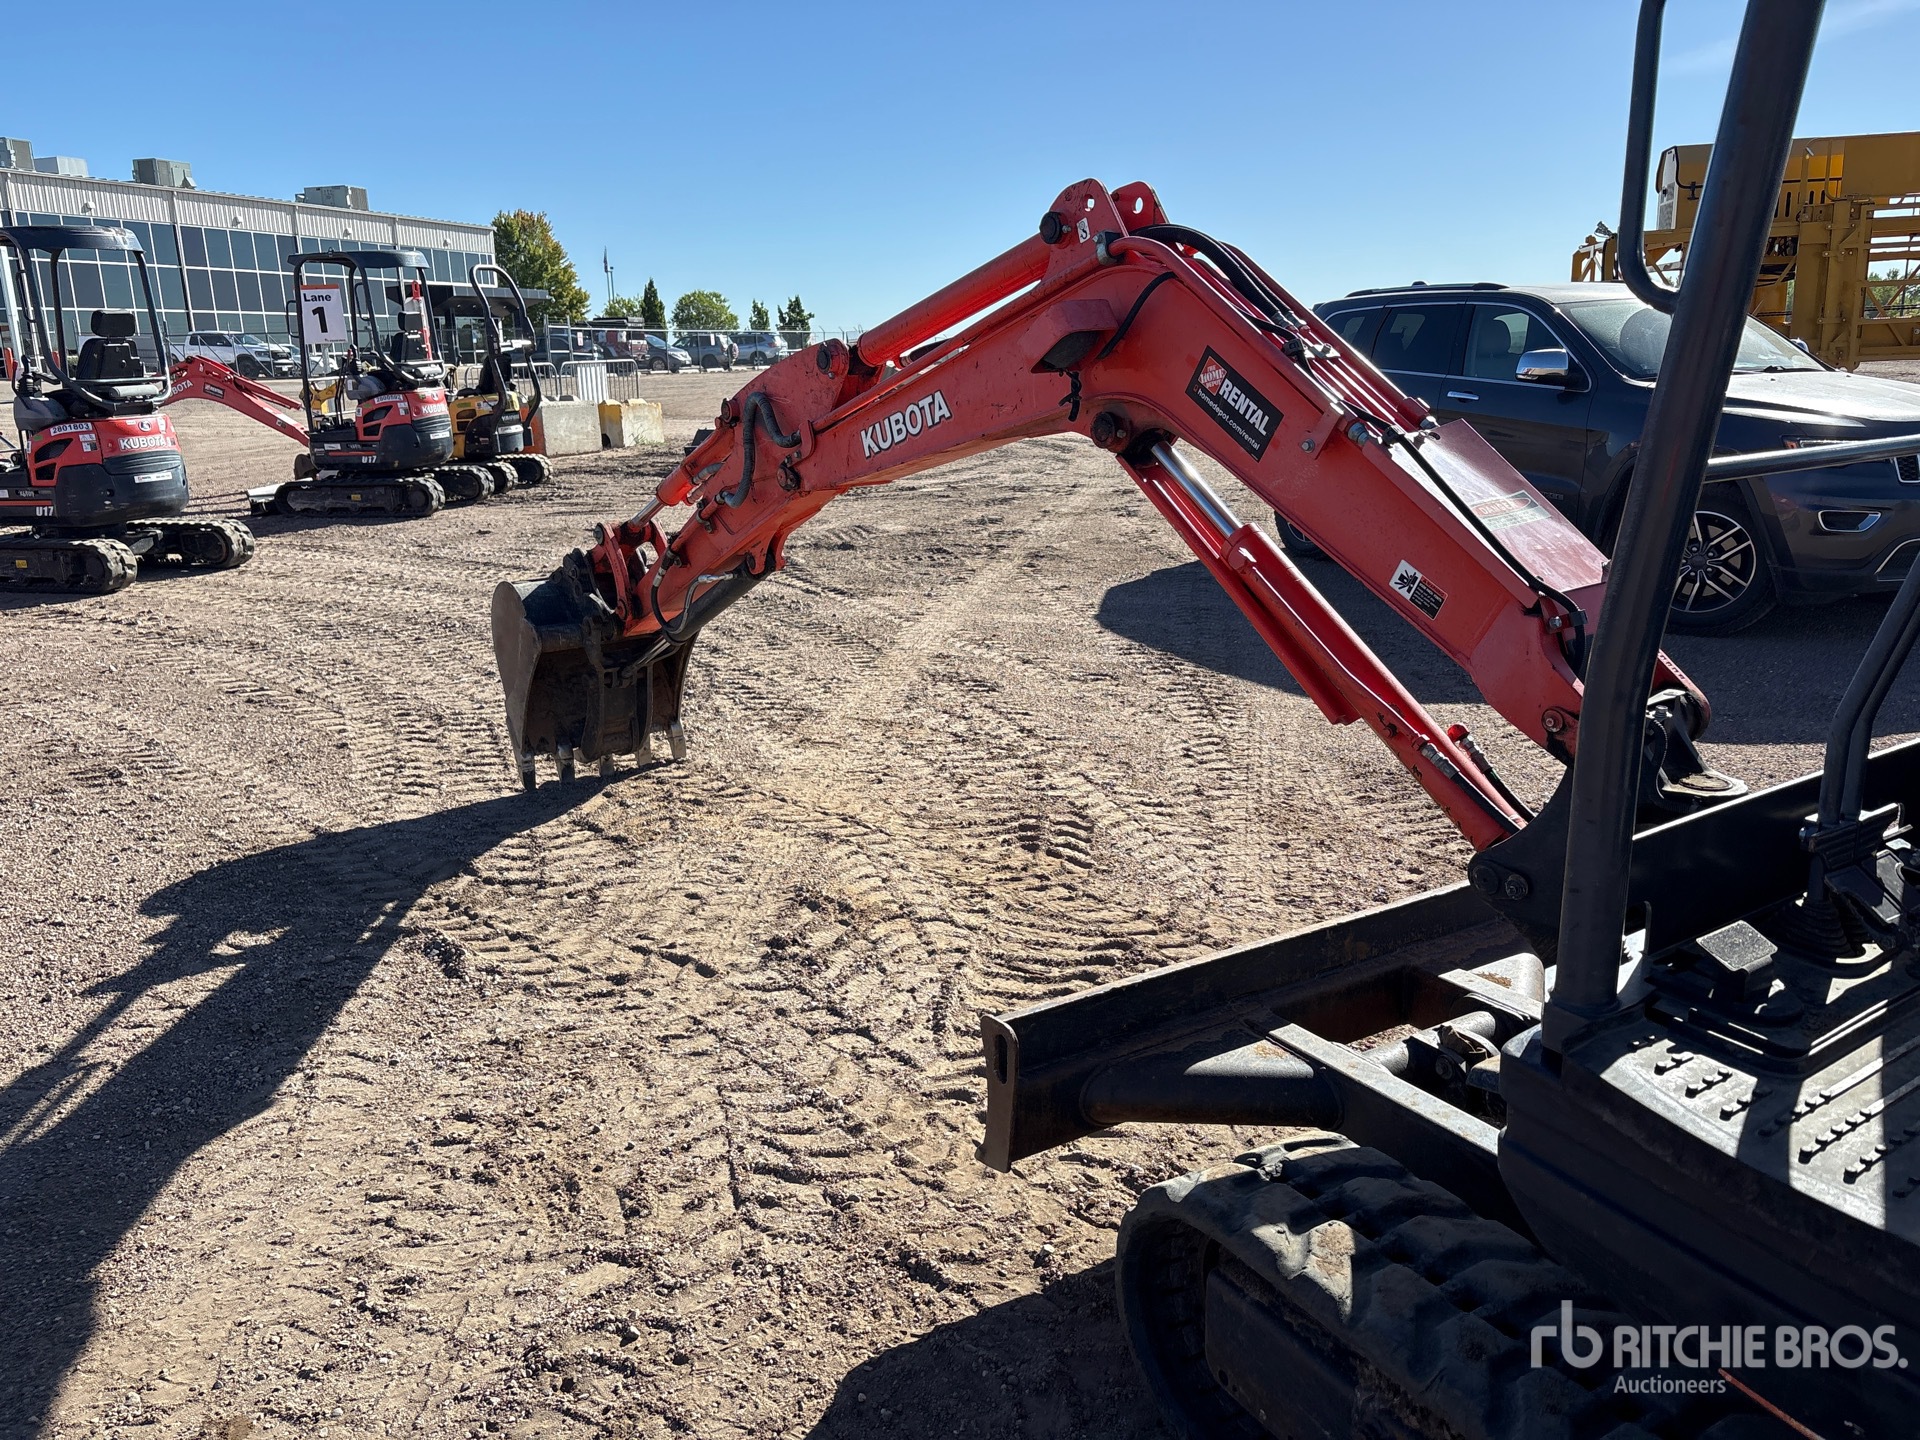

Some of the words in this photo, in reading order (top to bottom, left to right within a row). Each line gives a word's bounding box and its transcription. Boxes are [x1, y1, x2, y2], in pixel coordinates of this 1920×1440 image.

[303, 293, 332, 302] Lane
[311, 306, 329, 333] 1
[1198, 367, 1226, 383] HOME
[1218, 378, 1270, 437] RENTAL
[860, 389, 952, 459] KUBOTA
[1197, 387, 1261, 451] homedepot.com/rental
[52, 423, 90, 434] 2801803
[119, 436, 167, 451] KUBOTA
[36, 506, 54, 516] U17
